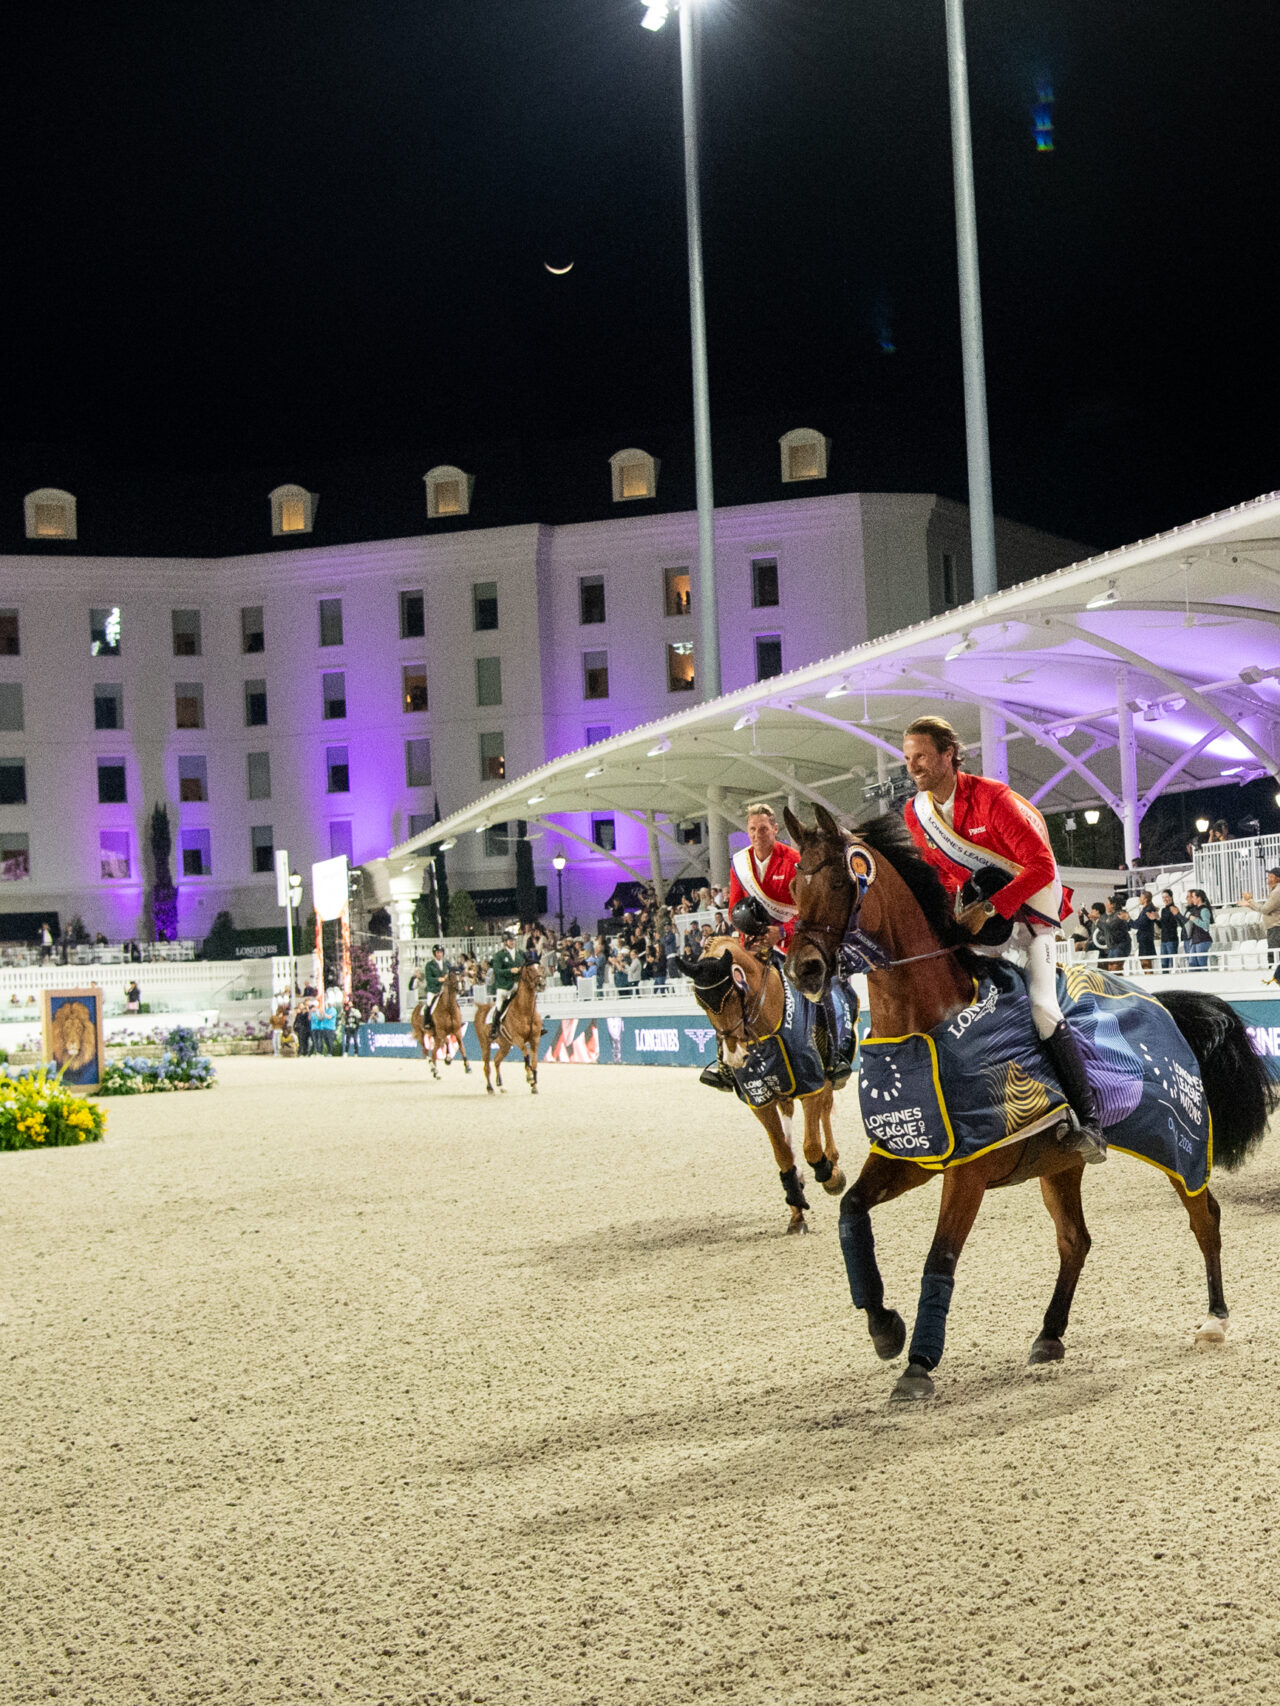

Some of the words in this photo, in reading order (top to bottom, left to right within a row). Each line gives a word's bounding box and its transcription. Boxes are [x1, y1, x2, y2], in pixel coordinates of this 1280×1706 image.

[928, 816, 963, 852] LONGINES
[235, 945, 278, 955] LONGINES
[634, 1028, 680, 1052] LONGINES
[865, 1107, 923, 1129] LONGINES
